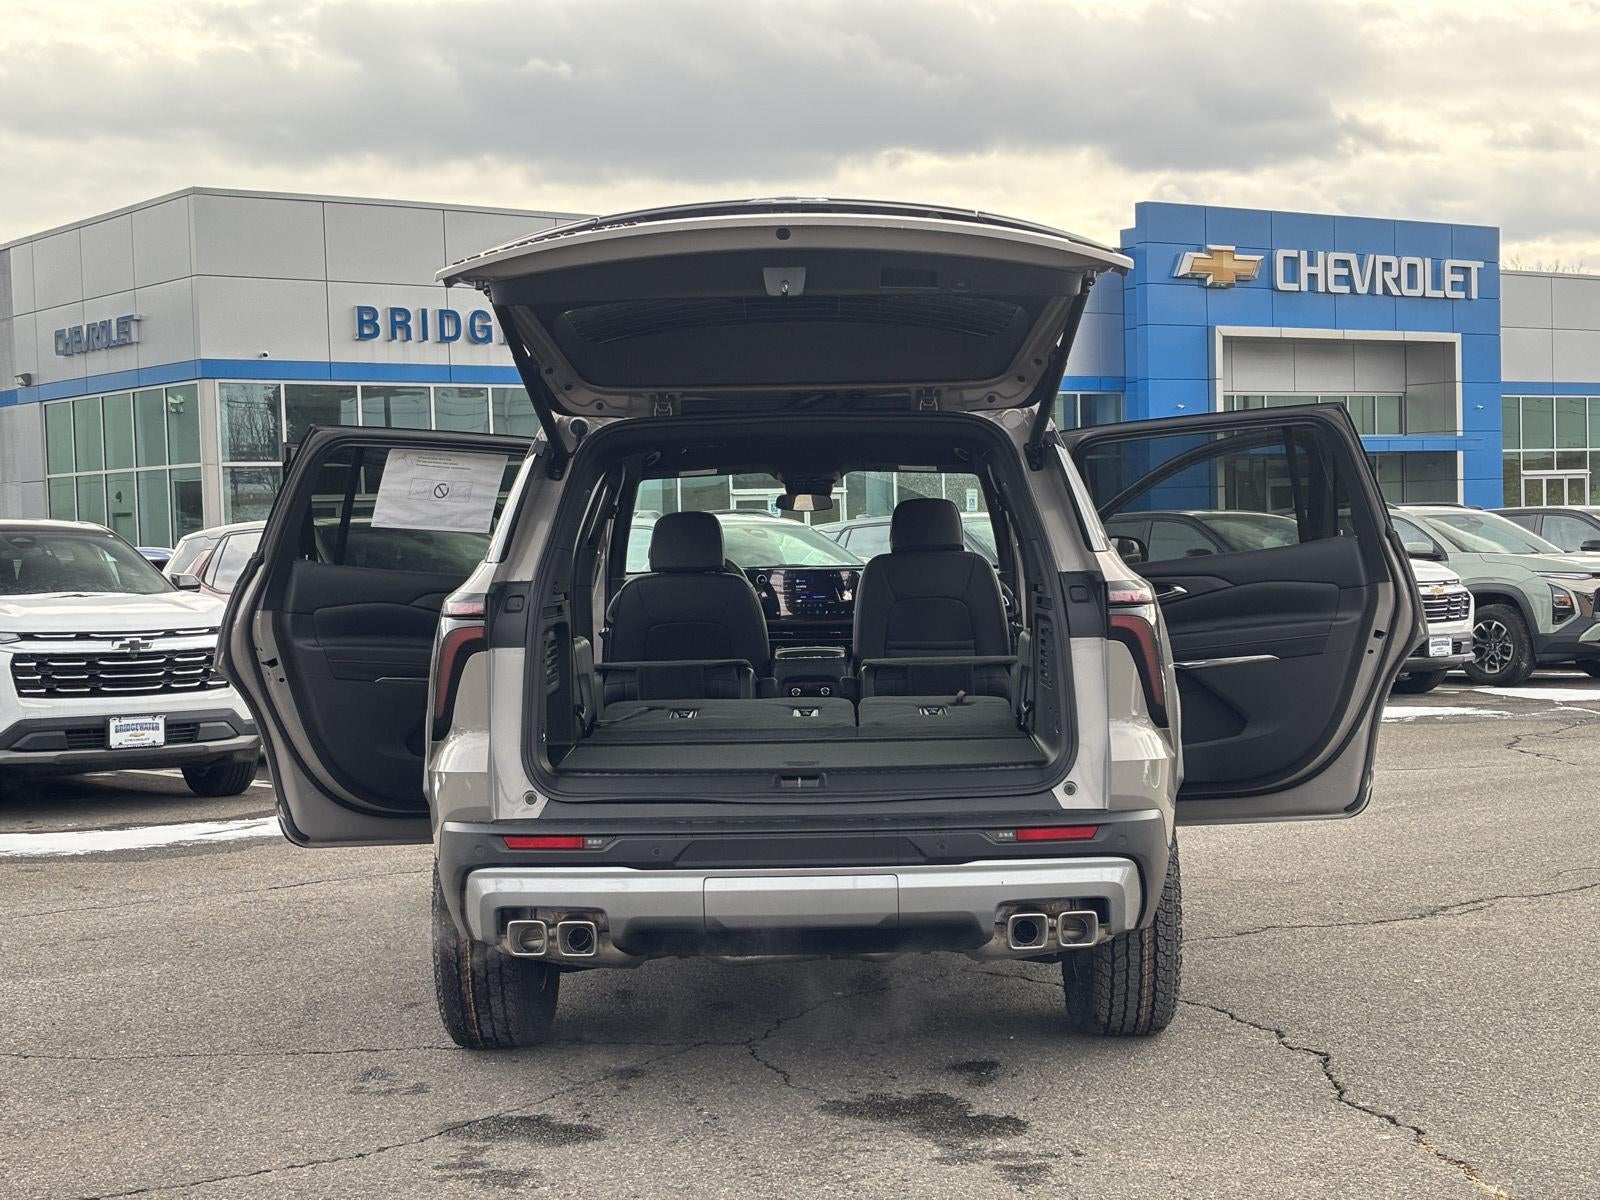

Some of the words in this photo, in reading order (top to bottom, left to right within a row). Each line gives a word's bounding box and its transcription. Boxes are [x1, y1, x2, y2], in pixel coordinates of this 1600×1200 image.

[1275, 249, 1484, 299] CHEVROLET
[54, 314, 140, 356] CHEVROLET
[353, 306, 508, 345] BRIDG
[115, 723, 160, 733] BRIDGEWATER
